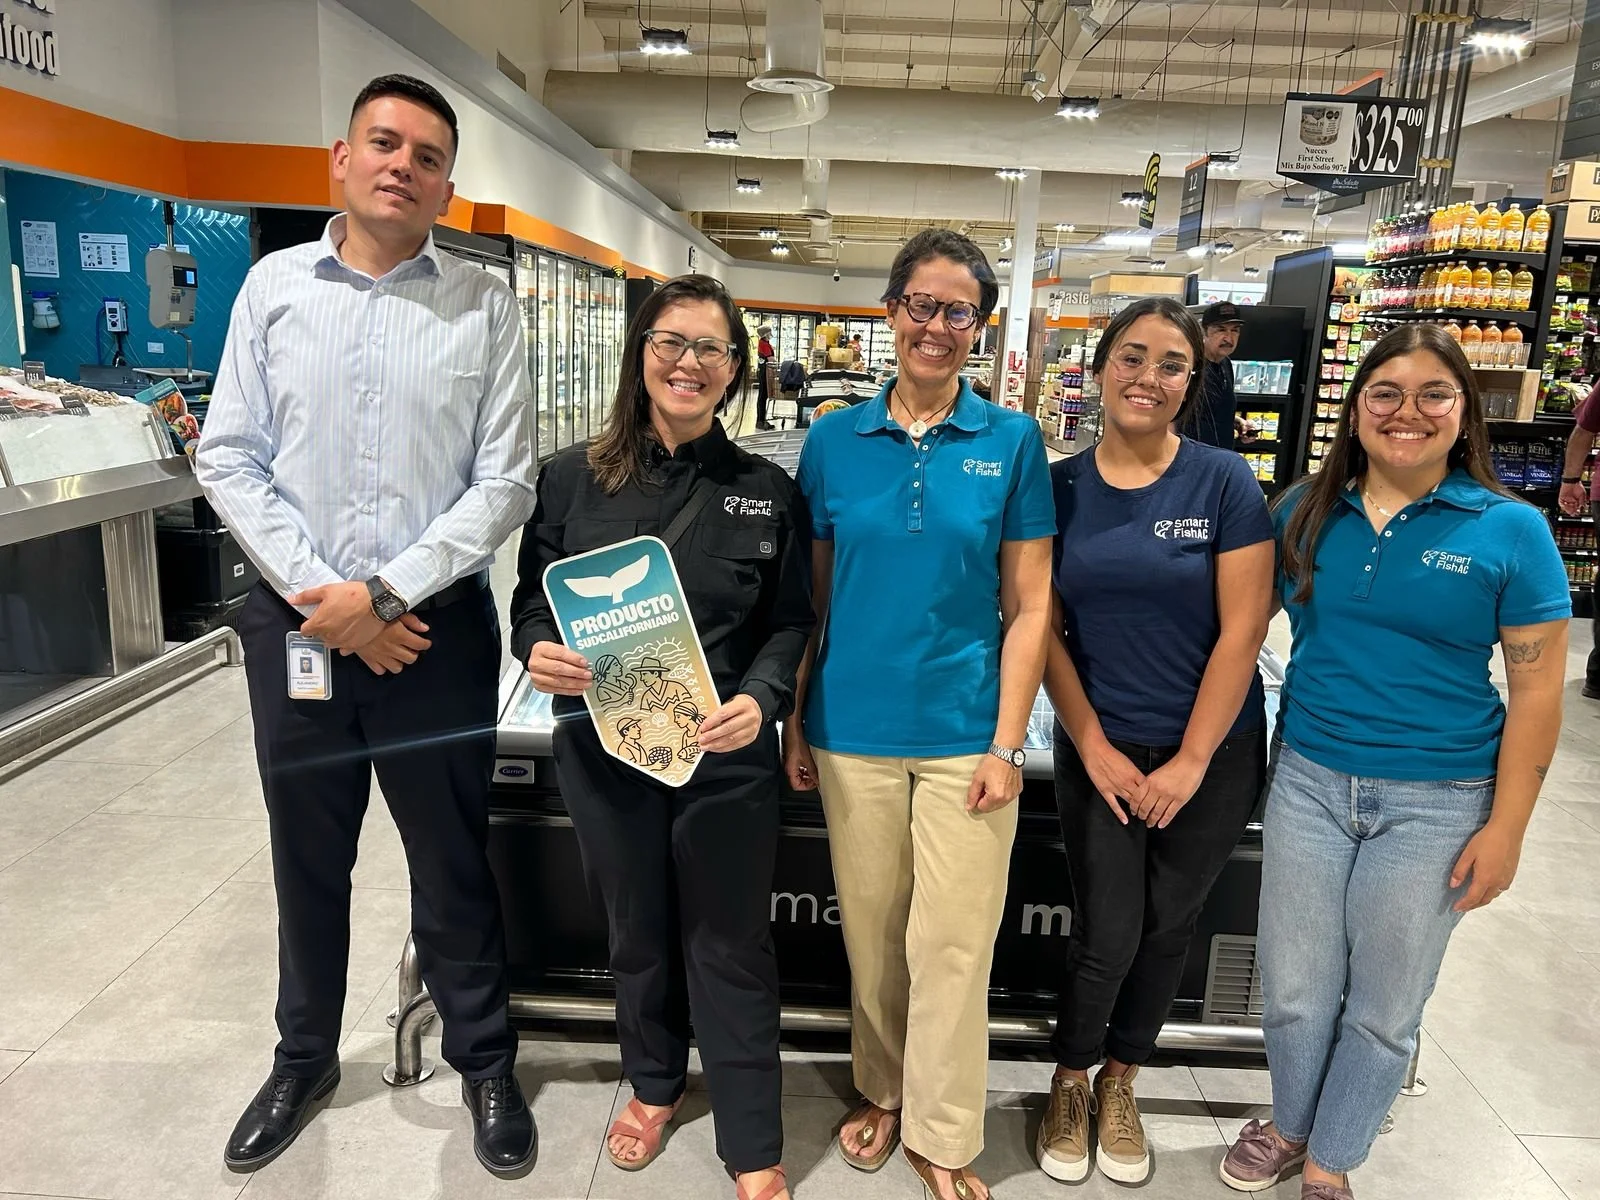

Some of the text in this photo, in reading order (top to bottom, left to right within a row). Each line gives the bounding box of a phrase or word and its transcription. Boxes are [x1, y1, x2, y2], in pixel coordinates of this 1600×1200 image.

[0, 12, 61, 76] food
[1304, 146, 1328, 155] Nueces
[1297, 155, 1334, 163] First Street
[1295, 162, 1311, 171] Bajo
[1312, 163, 1331, 171] Sodio
[1331, 164, 1347, 173] 907g
[1188, 172, 1198, 192] 12
[976, 460, 1002, 469] Smart
[740, 497, 772, 507] Smart
[1439, 551, 1472, 565] Smart
[570, 593, 675, 639] PRODUCTO
[575, 611, 680, 651] SUDCALIFORNIANO
